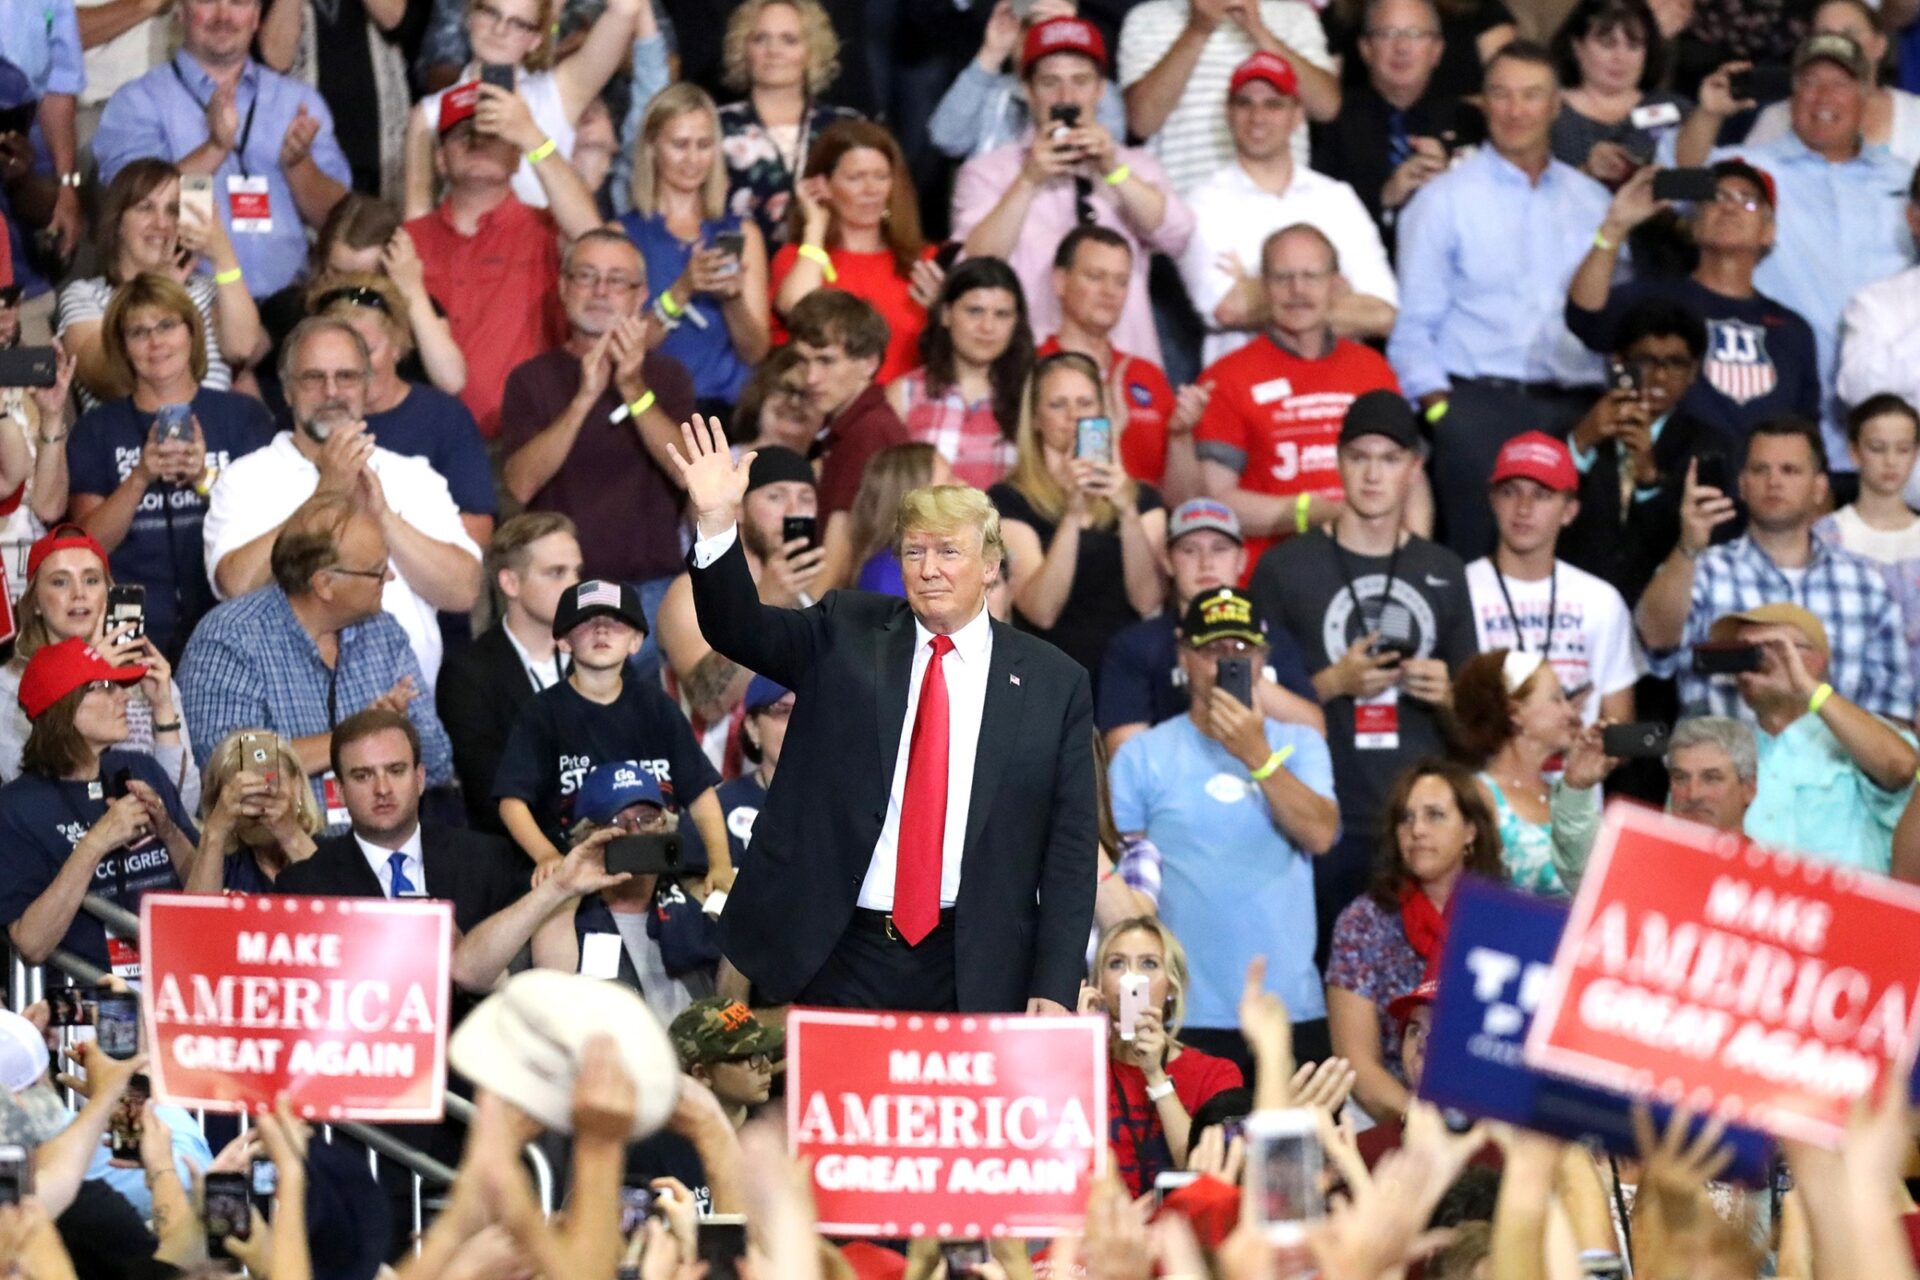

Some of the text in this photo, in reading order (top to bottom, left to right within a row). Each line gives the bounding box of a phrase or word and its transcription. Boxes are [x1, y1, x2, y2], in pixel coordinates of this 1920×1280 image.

[614, 767, 636, 782] Go
[236, 930, 342, 968] MAKE
[154, 971, 436, 1034] AMERICA
[1575, 899, 1908, 1062] AMERICA
[171, 1032, 416, 1078] GREAT AGAIN
[888, 1047, 997, 1086] MAKE
[796, 1089, 1096, 1150] AMERICA
[814, 1153, 1080, 1195] GREAT AGAIN
